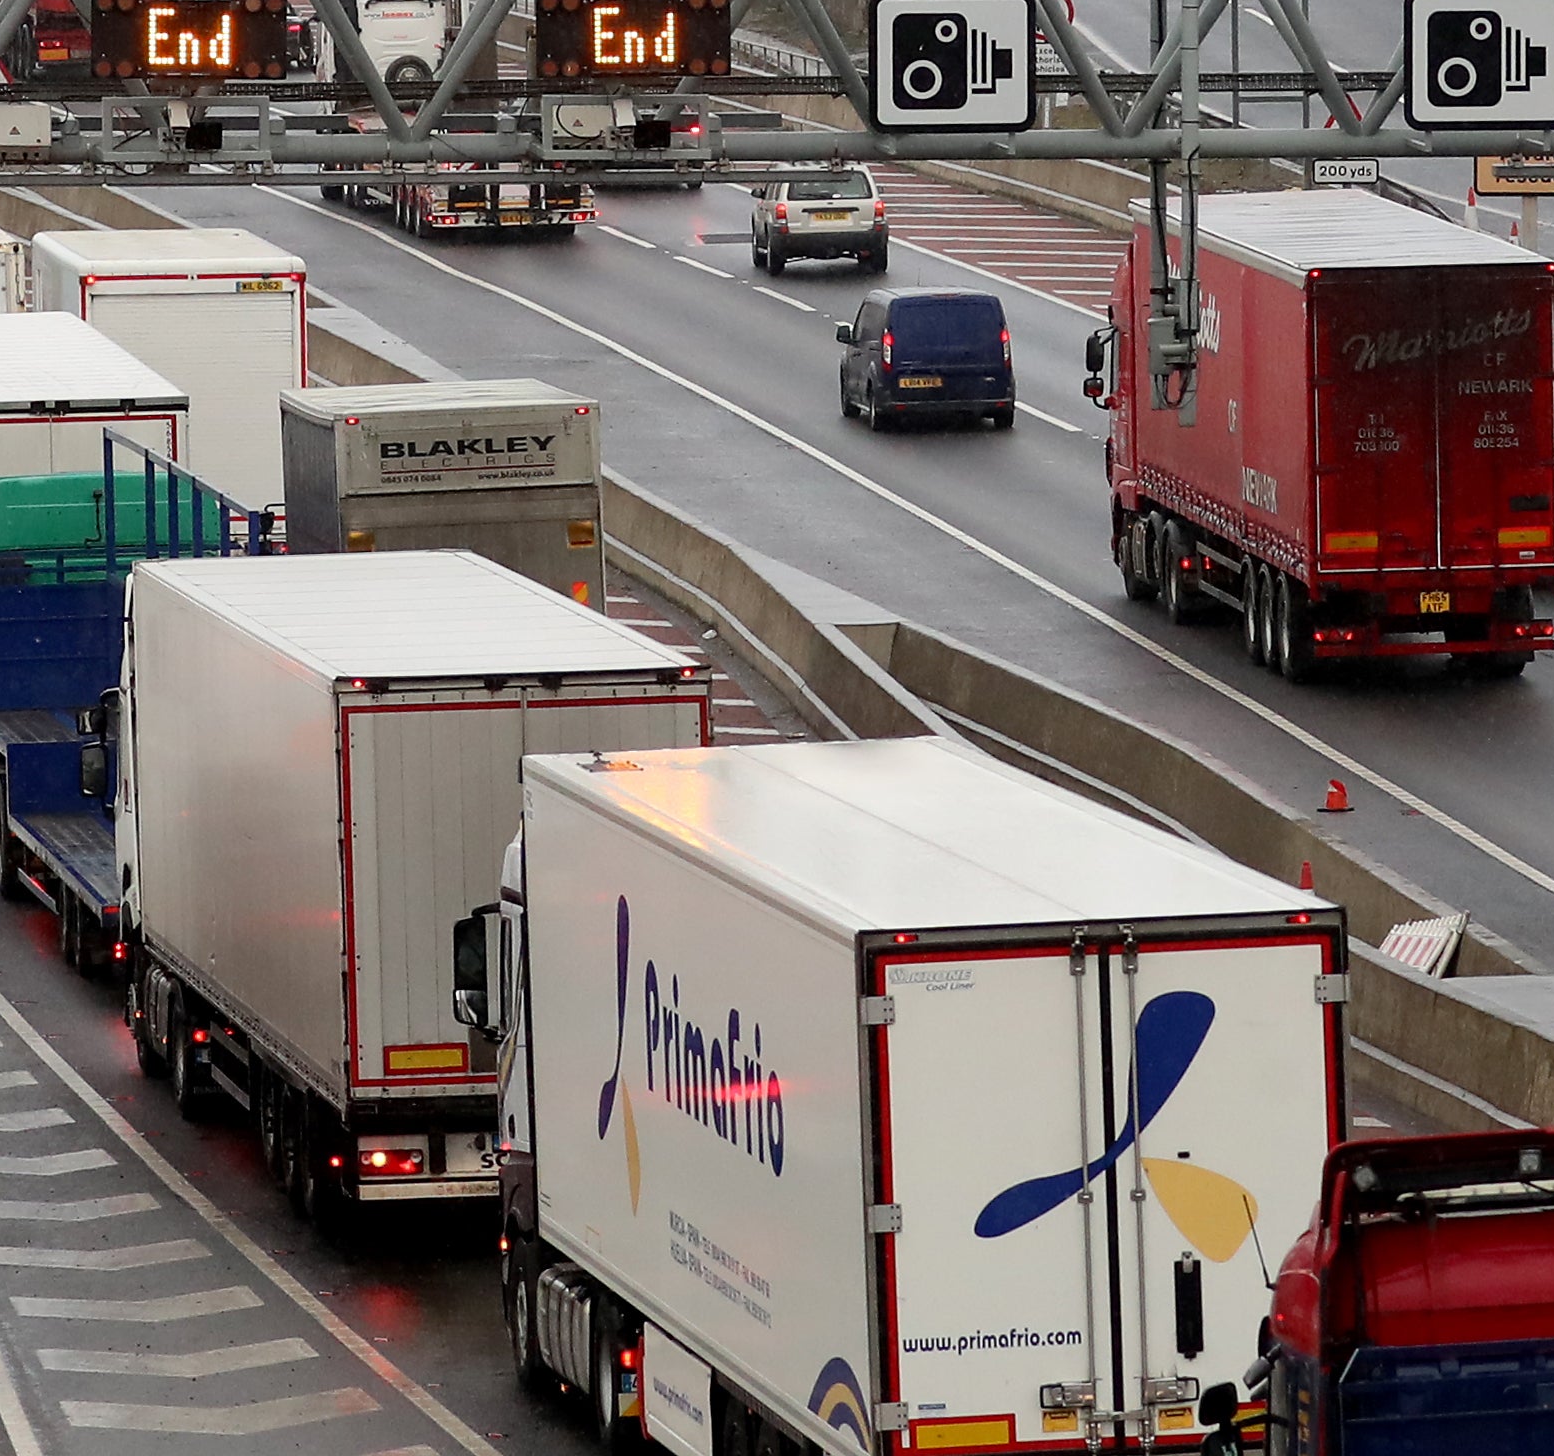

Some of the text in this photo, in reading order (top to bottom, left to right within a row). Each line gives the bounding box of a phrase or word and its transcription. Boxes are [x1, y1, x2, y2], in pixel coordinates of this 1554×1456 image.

[149, 8, 230, 65] End
[594, 7, 674, 63] End
[1319, 164, 1372, 180] 200 yds
[1458, 380, 1532, 394] NEWARK
[380, 435, 556, 459] BLAKLEY
[380, 453, 556, 471] ELECTRICS
[903, 1328, 1082, 1356] www.primafrio.com
